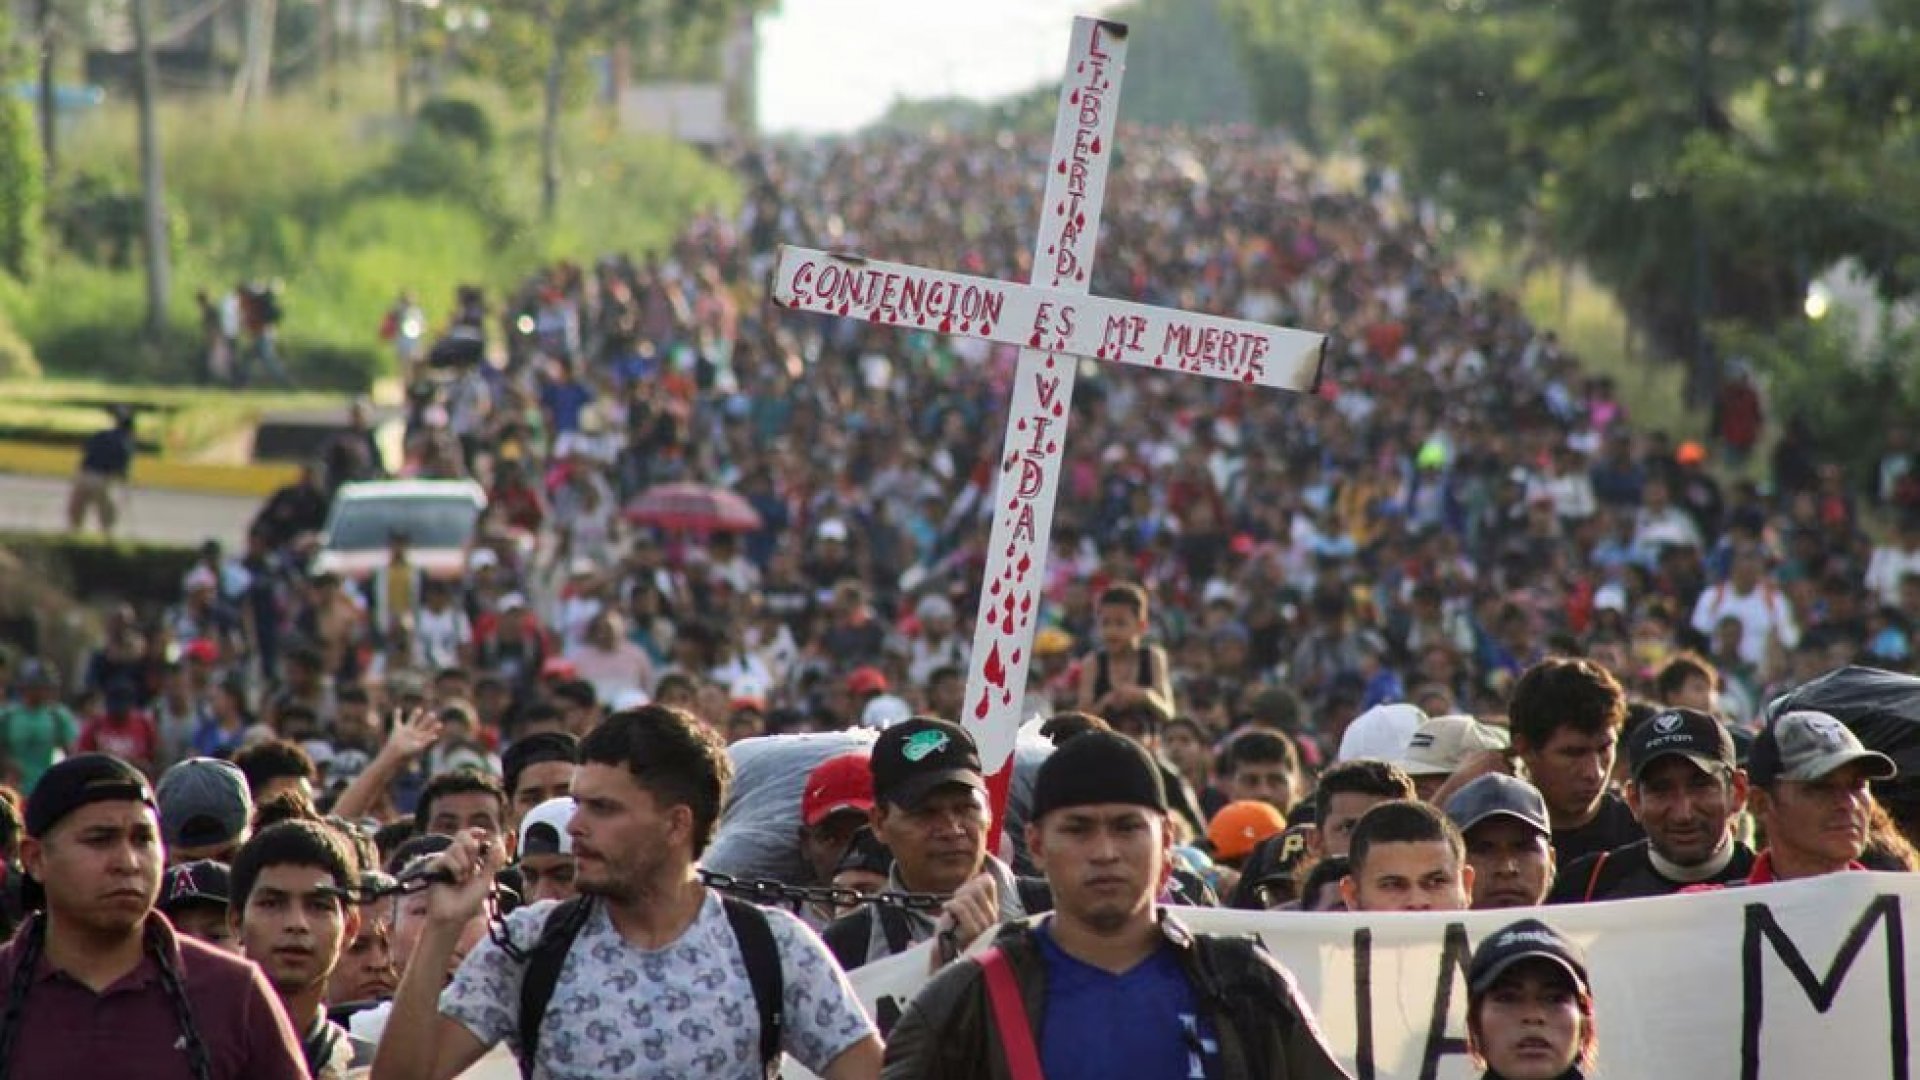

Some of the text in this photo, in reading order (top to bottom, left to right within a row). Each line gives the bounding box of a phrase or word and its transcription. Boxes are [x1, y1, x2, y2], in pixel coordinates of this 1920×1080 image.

[1056, 20, 1111, 277] LIBERTAD
[791, 261, 1270, 376] CONTENCION ES MI MUERTE
[1013, 372, 1061, 544] VIDA
[169, 866, 199, 899] A
[1280, 834, 1304, 862] P
